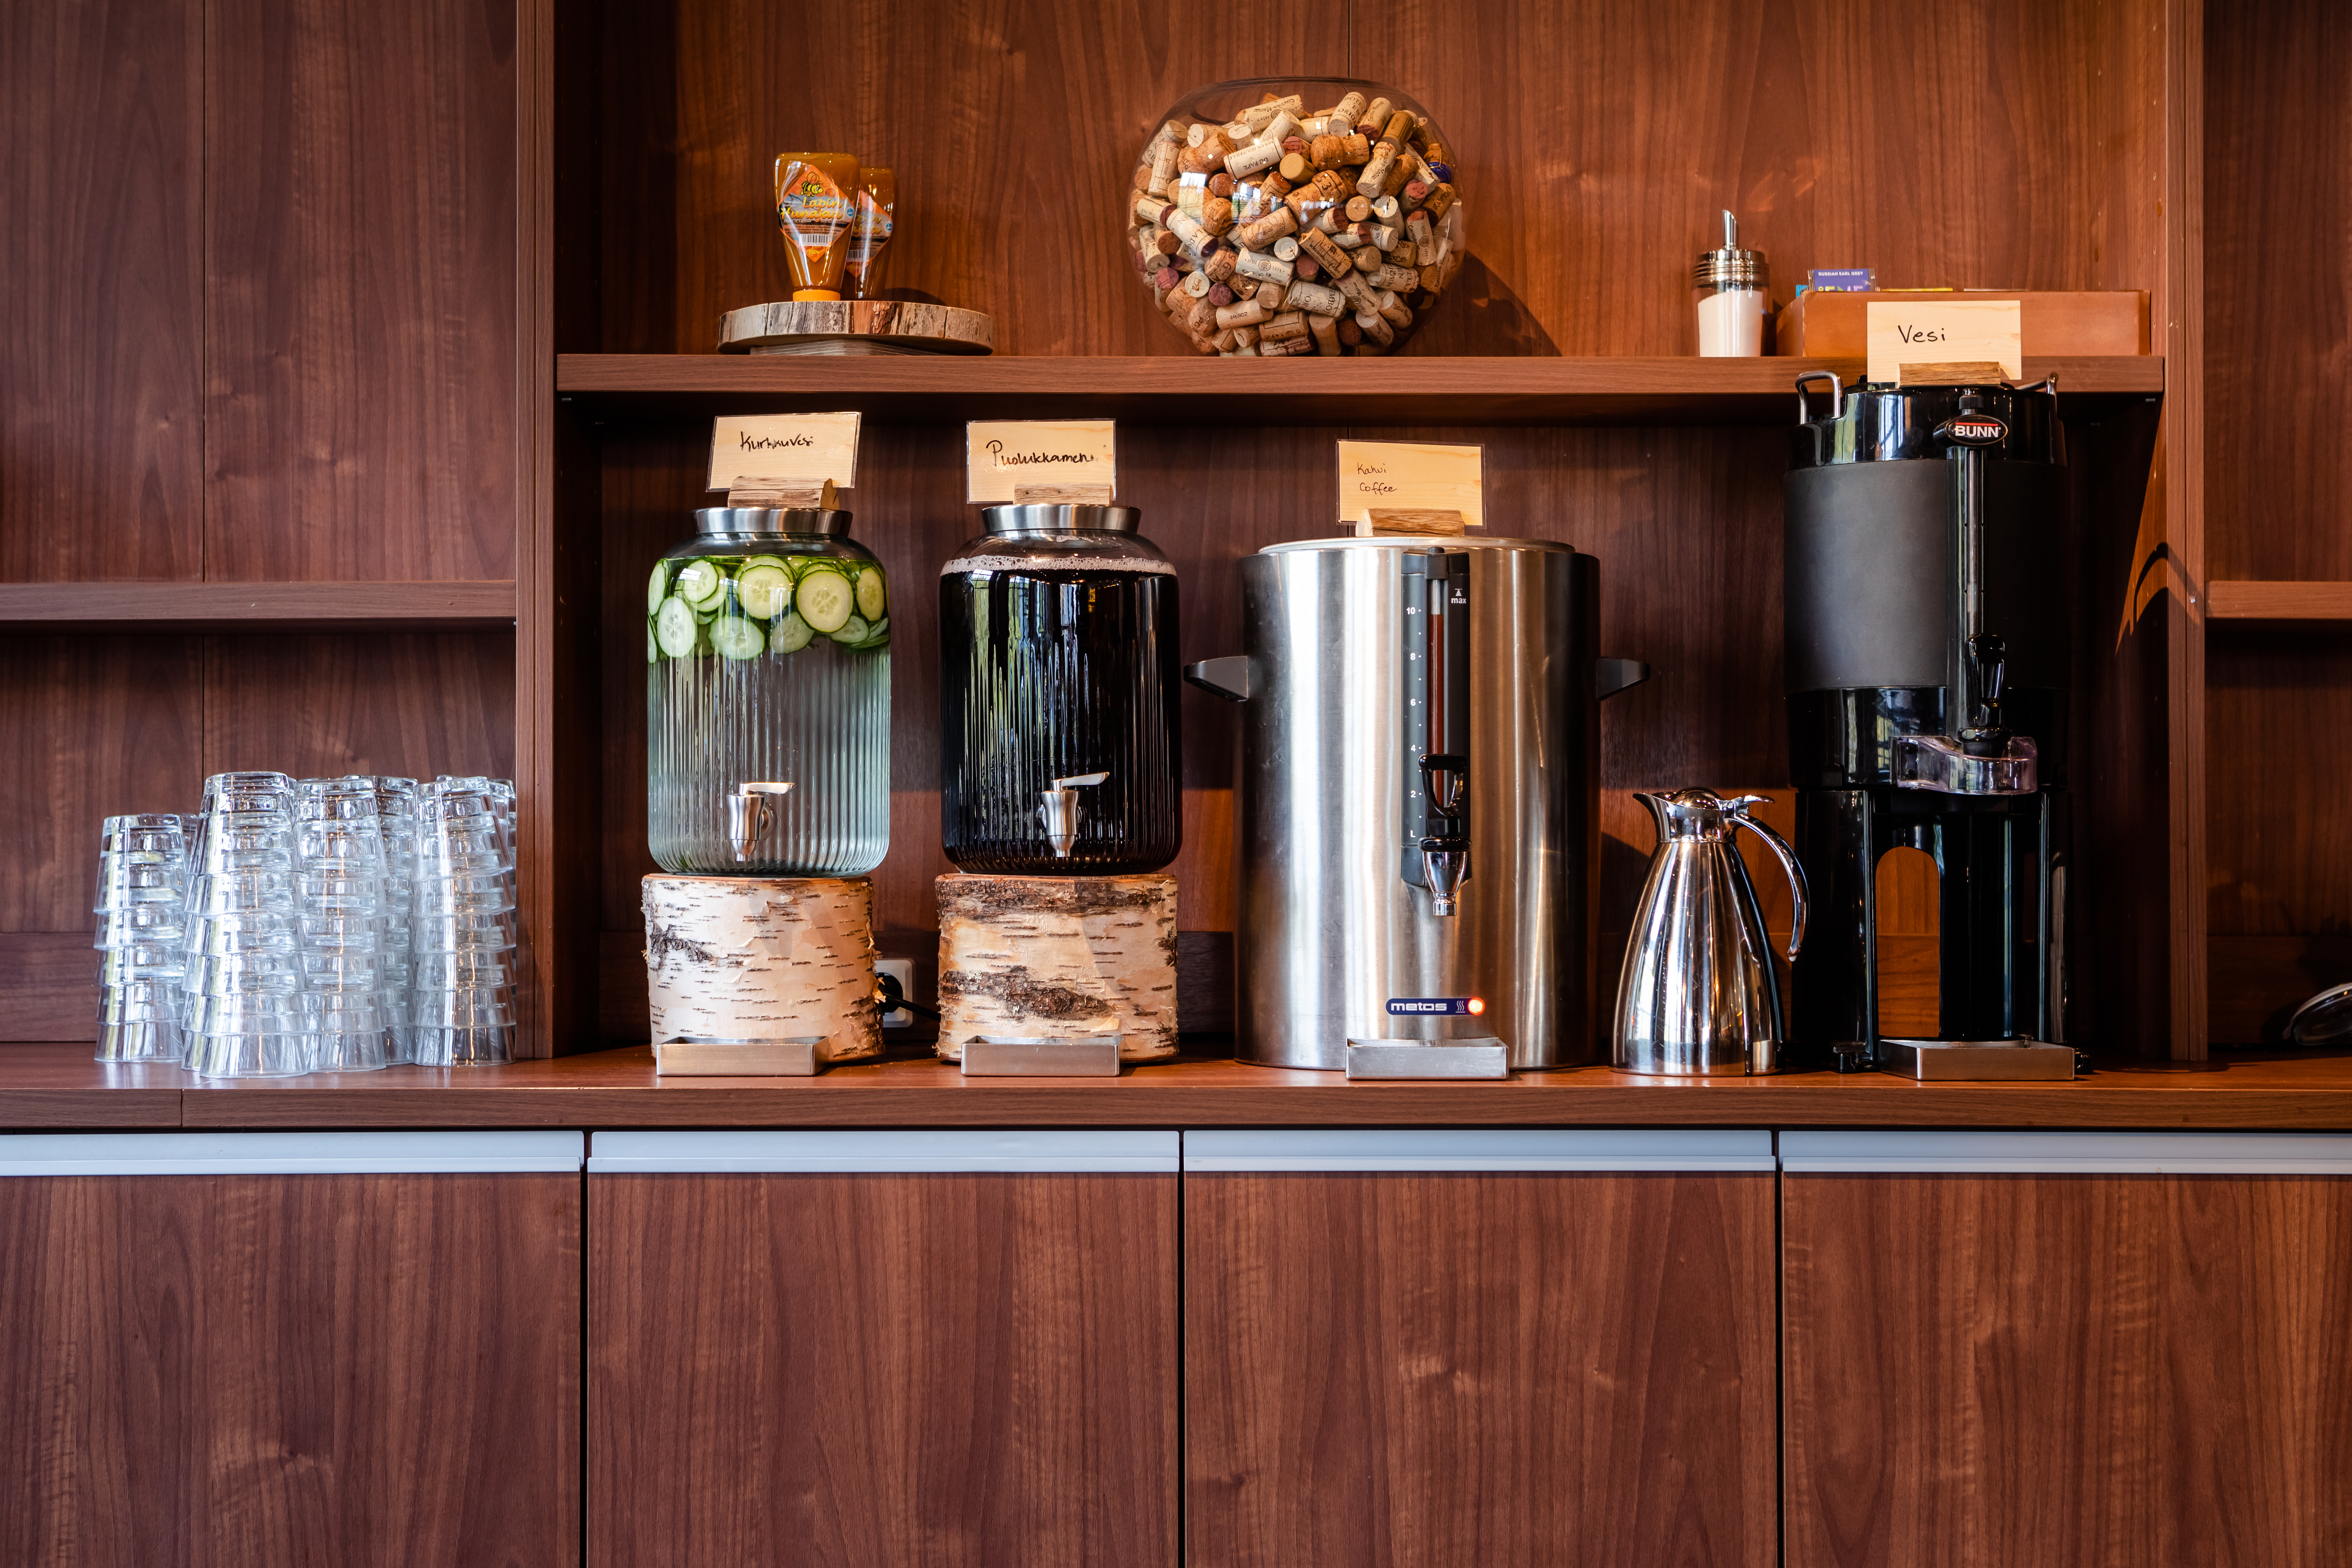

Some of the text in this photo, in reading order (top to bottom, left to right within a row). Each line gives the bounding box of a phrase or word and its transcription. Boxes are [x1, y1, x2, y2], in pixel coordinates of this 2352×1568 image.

[1229, 147, 1256, 160] BOUTEILLE
[1243, 161, 1259, 171] PAPE
[803, 197, 844, 212] Lapin
[781, 207, 843, 222] Hunajaa
[1897, 324, 1946, 344] Vesi
[1955, 425, 1998, 438] BUNN
[1360, 482, 1398, 495] Coffee
[1391, 1002, 1447, 1011] metos
